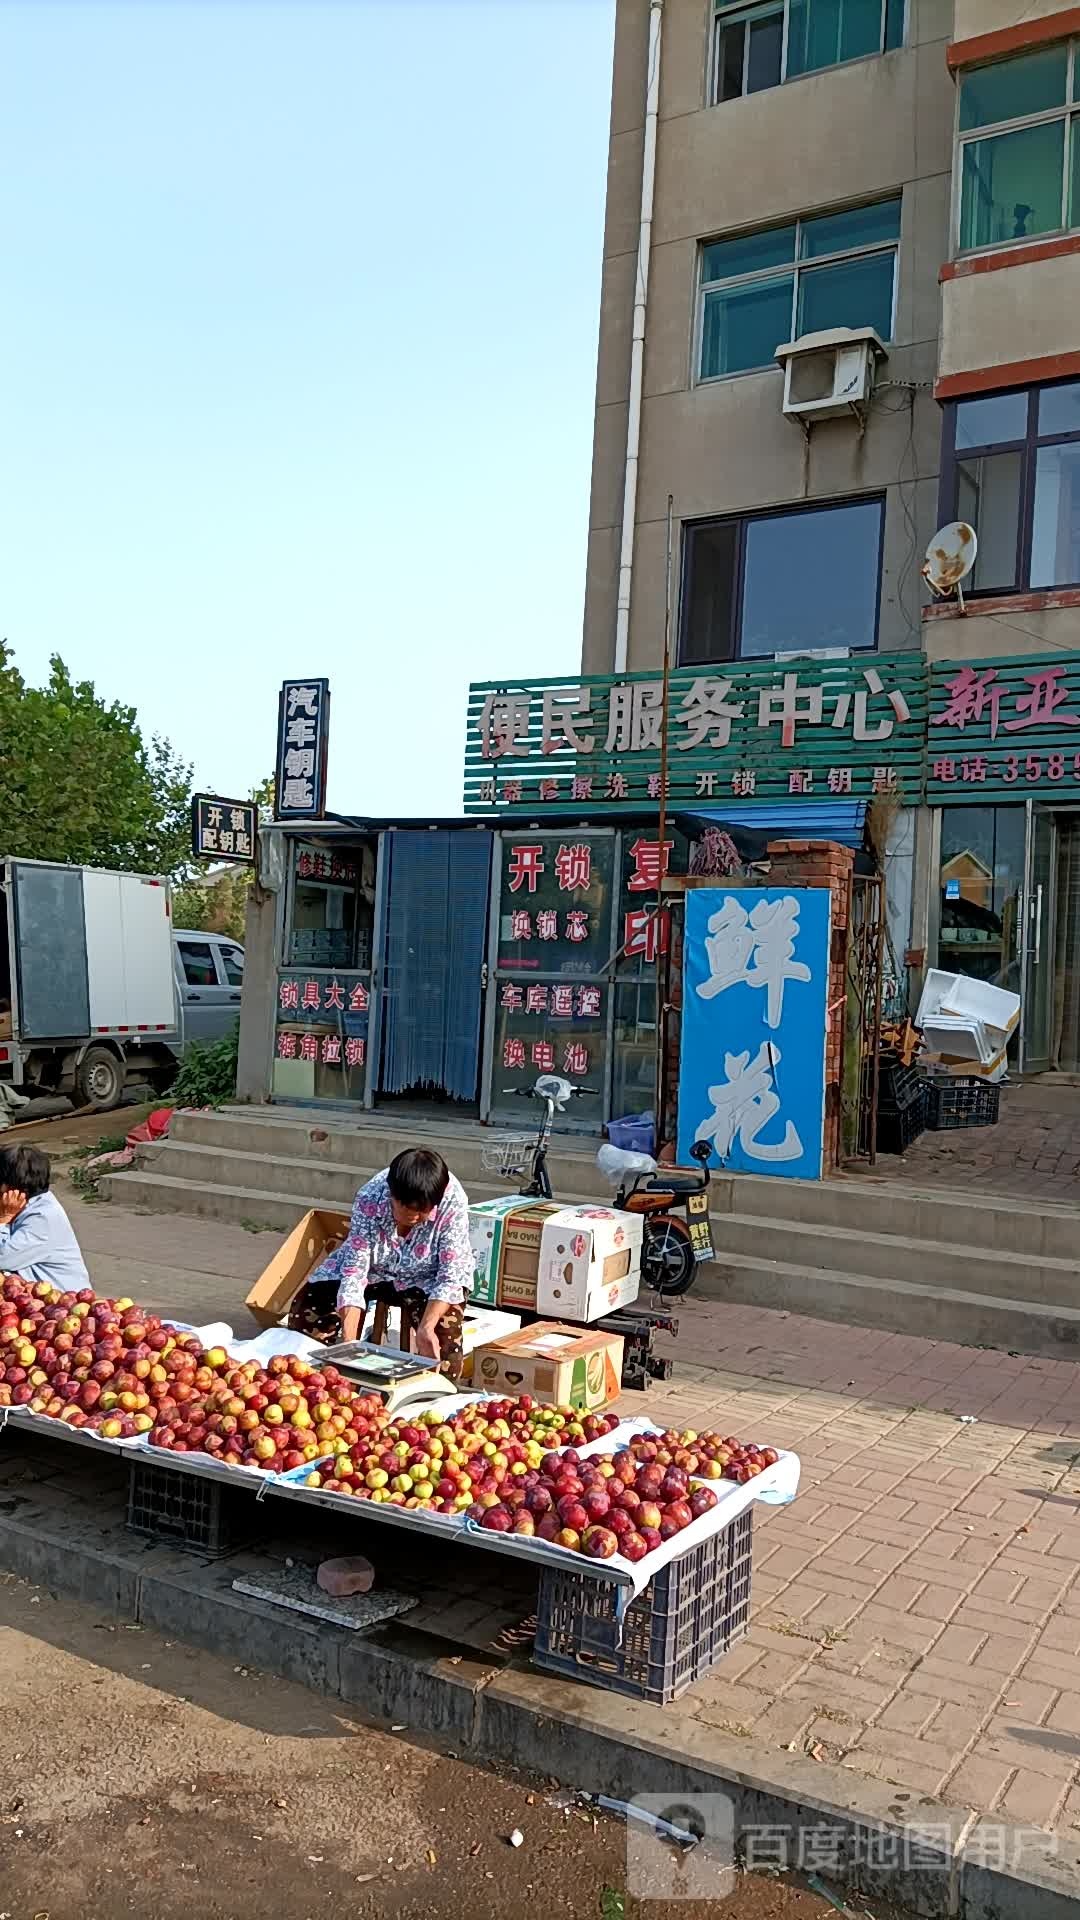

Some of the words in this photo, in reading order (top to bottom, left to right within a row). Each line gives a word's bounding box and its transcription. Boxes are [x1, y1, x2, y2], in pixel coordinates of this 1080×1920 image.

[475, 669, 911, 758] 便民服务中心
[930, 666, 1080, 741] 新亚
[282, 687, 318, 808] 汽车钥匙
[208, 806, 246, 831] 开锁
[202, 827, 251, 853] 配钥匙
[508, 844, 592, 893] 开锁
[624, 838, 675, 962] 复印
[511, 910, 588, 942] 换锁芯
[279, 980, 369, 1011] 锁具大全
[500, 982, 601, 1017] 车库遥控
[503, 1038, 588, 1075] 换电池
